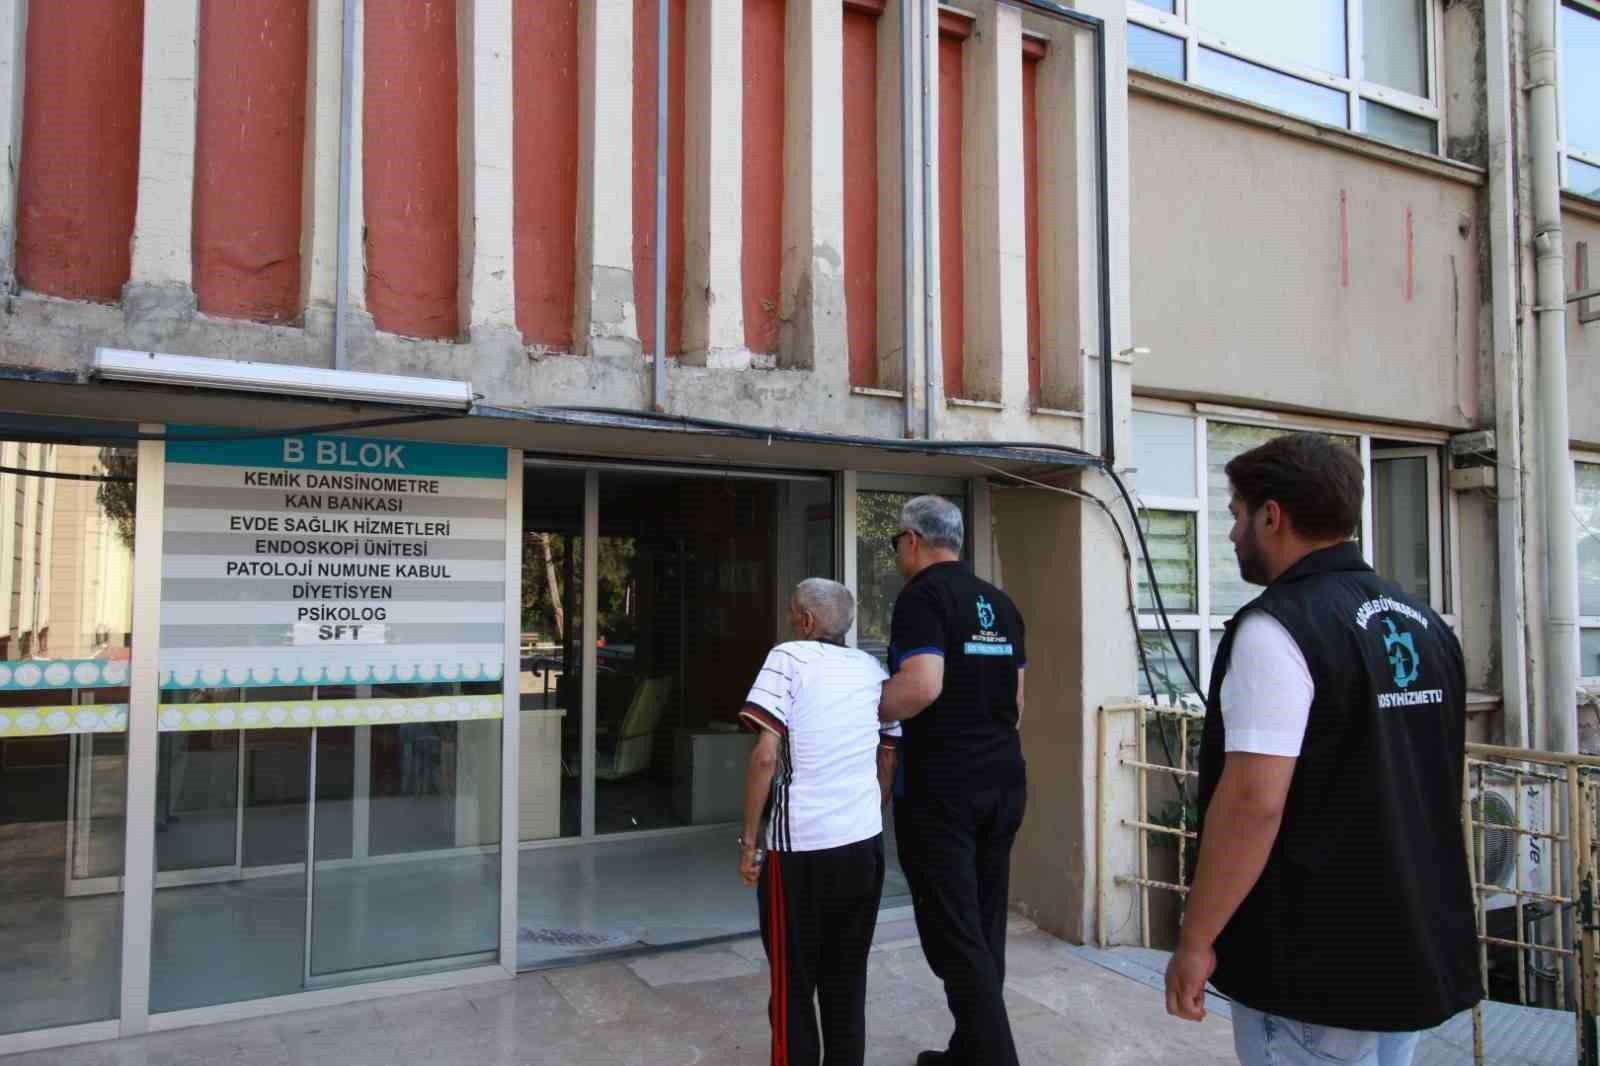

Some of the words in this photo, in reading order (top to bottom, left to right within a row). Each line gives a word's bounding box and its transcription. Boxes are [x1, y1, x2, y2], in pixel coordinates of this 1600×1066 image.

[283, 438, 304, 463] B
[316, 440, 406, 469] BLOK
[244, 470, 301, 488] KEMİK
[306, 473, 439, 494] DANSİNOMETRE
[285, 494, 322, 509] KAN
[328, 496, 403, 512] BANKASI
[230, 516, 279, 532] EVDE
[284, 515, 348, 534] SAĞLIK
[354, 518, 450, 536] HİZMETLERİ
[255, 539, 359, 555] ENDOSKOPİ
[364, 539, 428, 557] ÜNİTESİ
[226, 560, 313, 577] PATOLOJİ
[318, 563, 390, 578] NUMUNE
[395, 564, 451, 578] KABUL
[292, 583, 392, 599] DİYETİSYEN
[297, 604, 386, 621] PSİKOLOG
[318, 625, 363, 641] SFT
